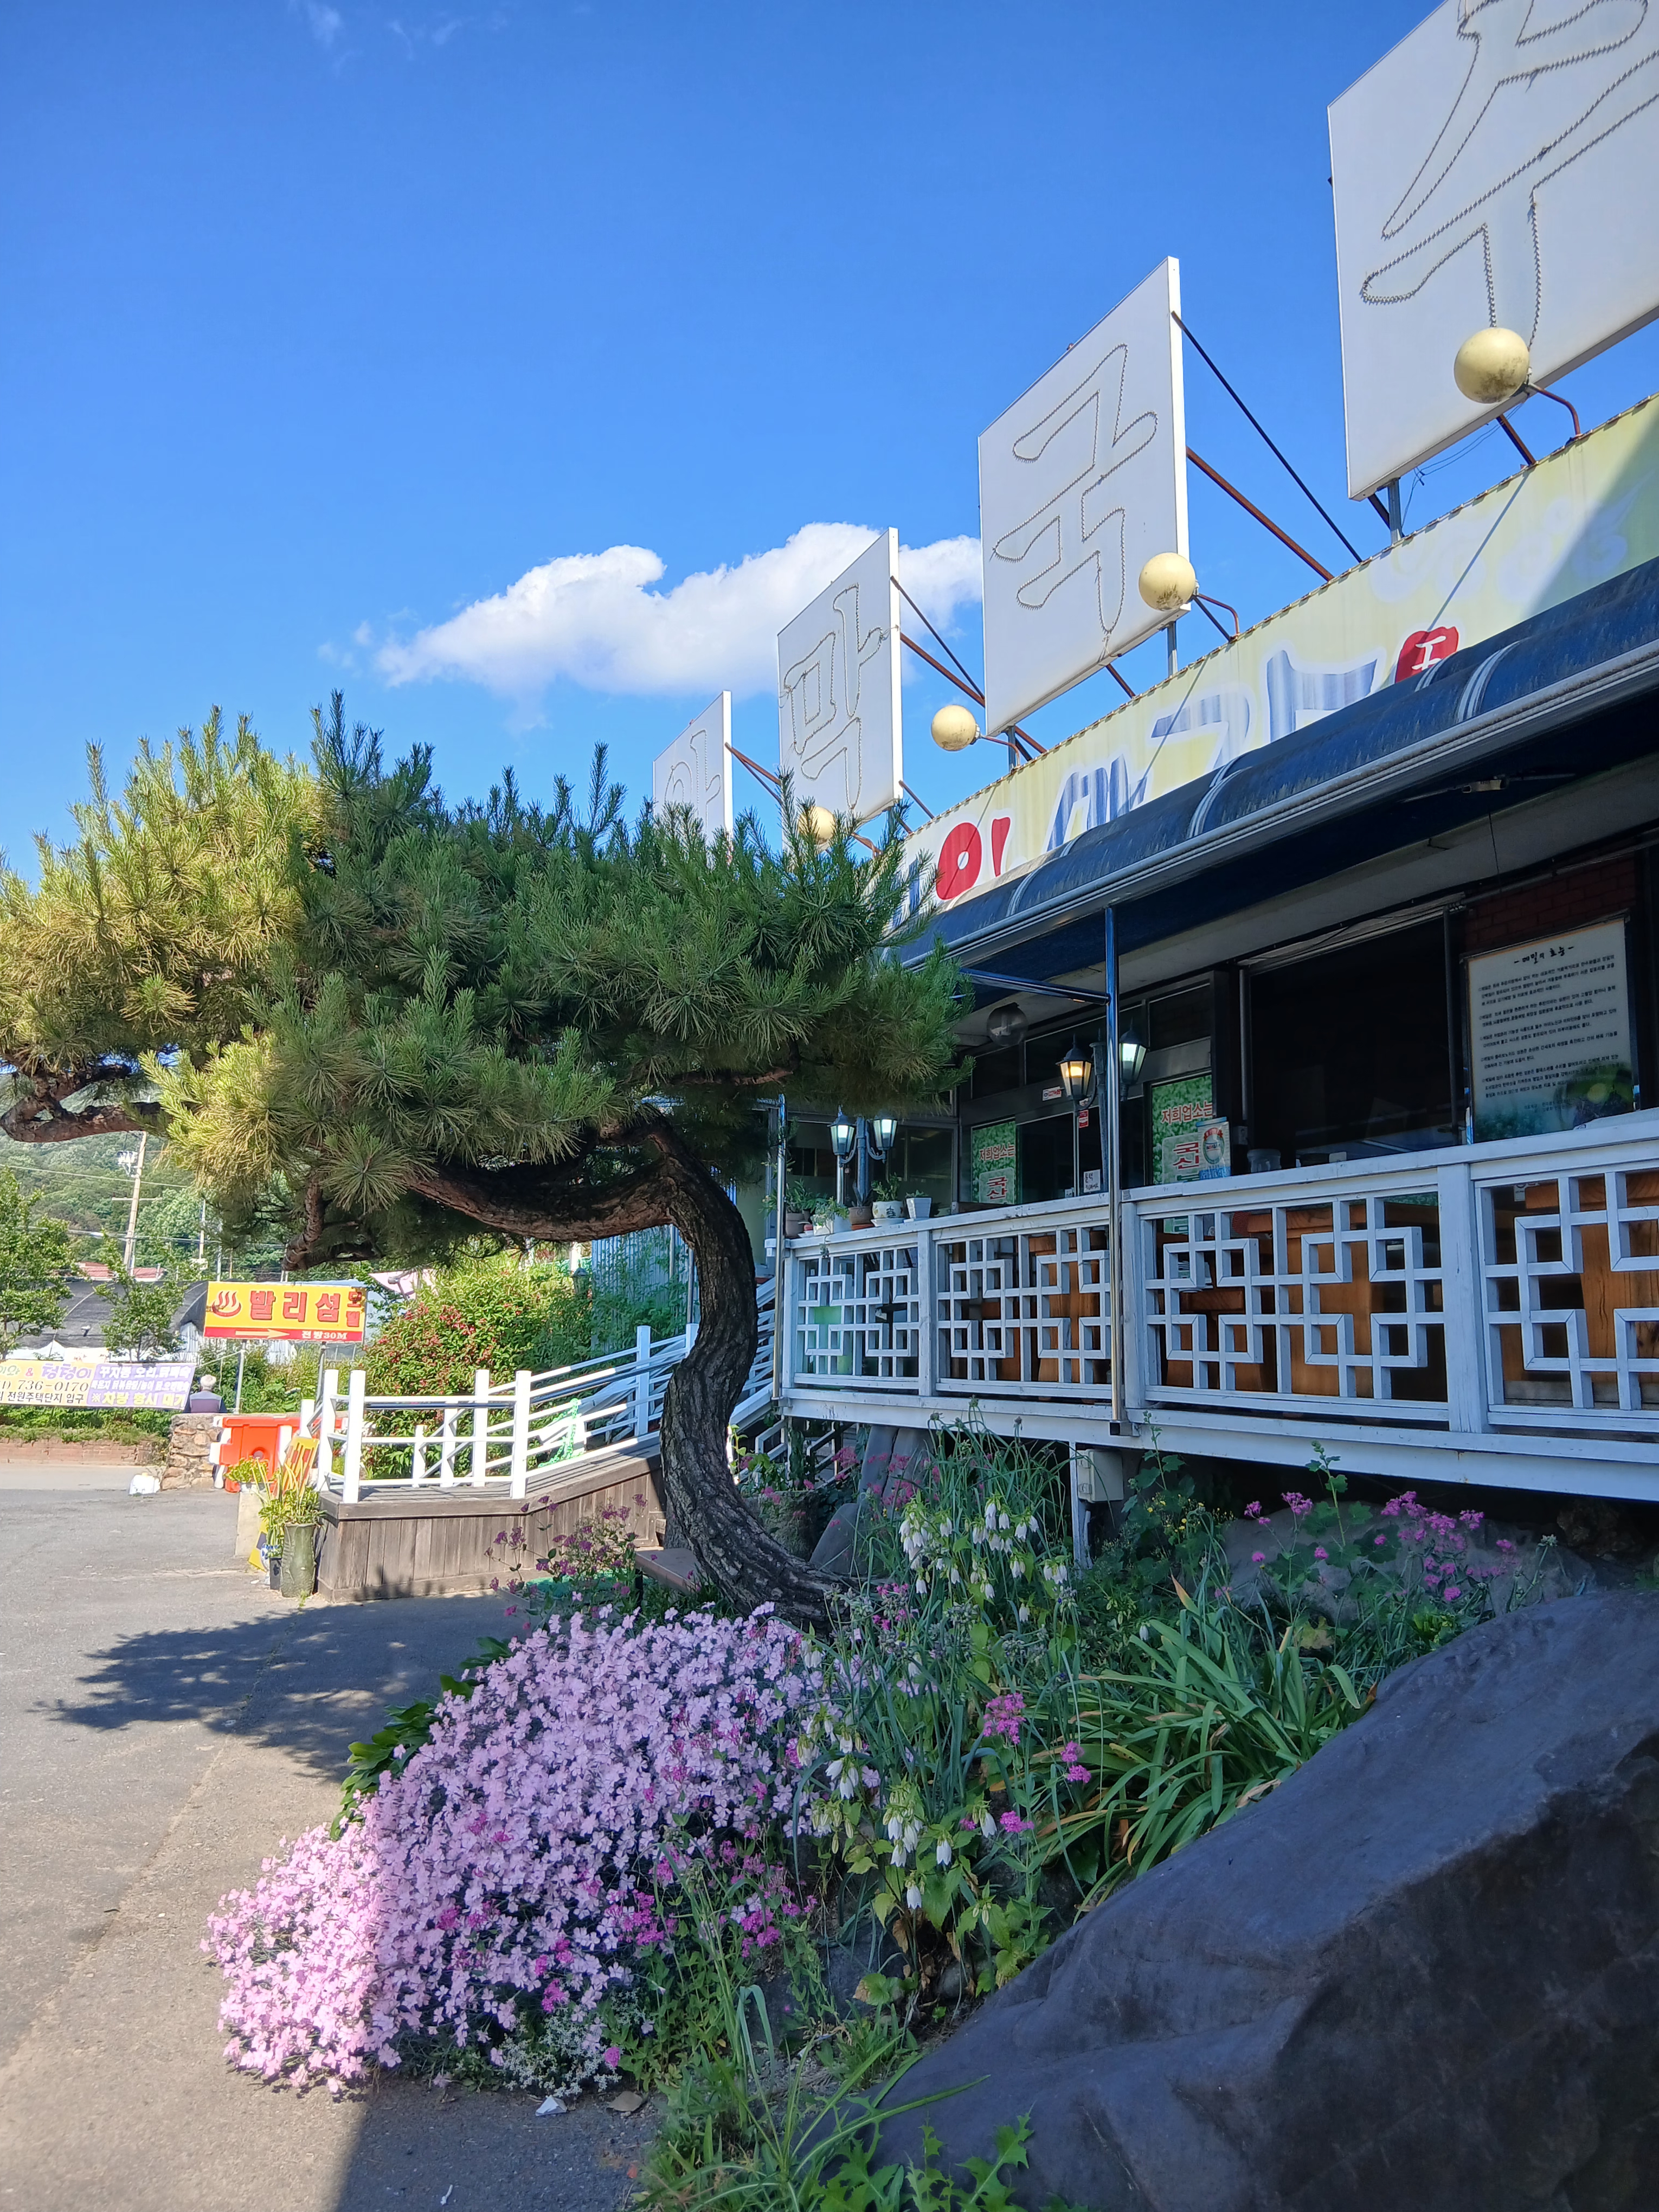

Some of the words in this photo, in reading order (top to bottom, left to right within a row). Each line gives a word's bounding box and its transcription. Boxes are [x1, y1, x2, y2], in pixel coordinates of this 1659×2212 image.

[1162, 1101, 1213, 1125] 저희업소는
[979, 1142, 1015, 1161] 저희업소는
[250, 1290, 340, 1323] 발리섬
[25, 1367, 33, 1377] &
[17, 1379, 89, 1392] 736-0170
[8, 1391, 63, 1404] 전원주택단지
[66, 1393, 84, 1404] 입구
[133, 1392, 159, 1406] 항시
[162, 1392, 187, 1408] 대기
